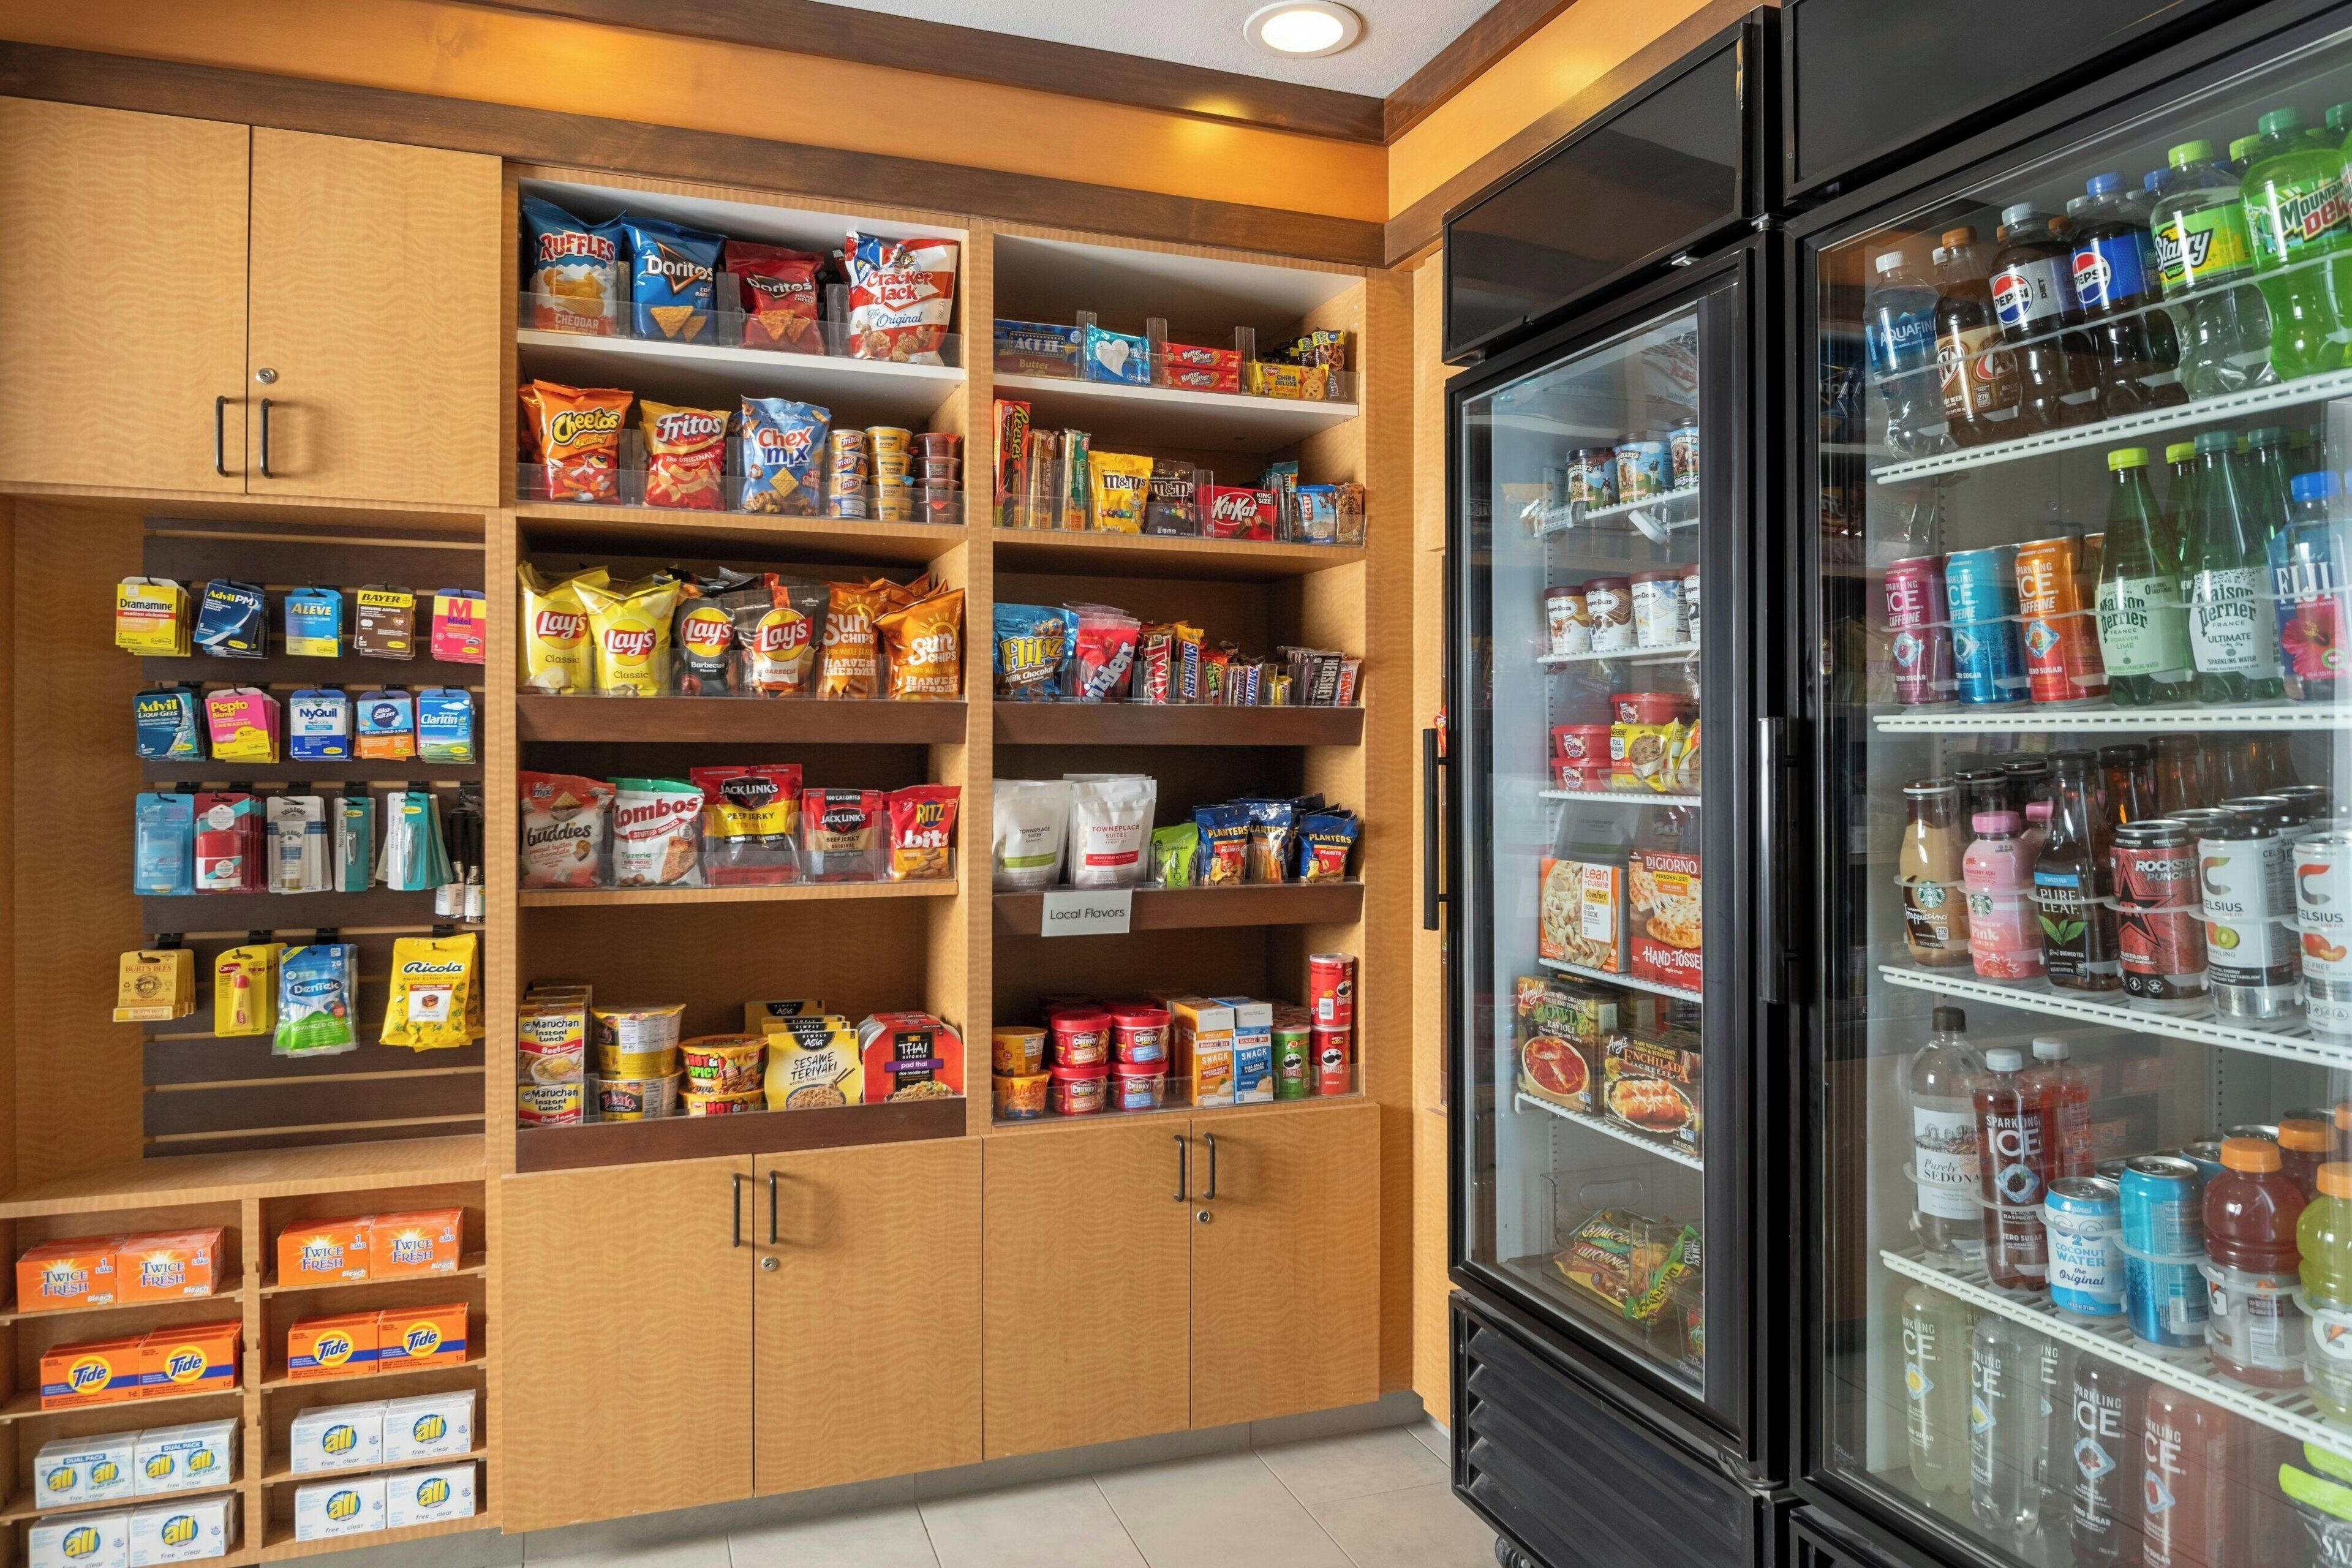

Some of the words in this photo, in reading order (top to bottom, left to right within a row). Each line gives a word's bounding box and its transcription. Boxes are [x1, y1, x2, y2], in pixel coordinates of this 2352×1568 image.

[540, 232, 615, 263] RUFFLES
[646, 254, 714, 282] Doritos
[745, 276, 813, 293] Doritos
[867, 271, 933, 287] Cracker
[873, 285, 919, 305] Jack
[1995, 290, 2029, 307] PEPSI
[556, 313, 599, 329] CHEDDAR
[876, 312, 922, 328] Original
[1015, 337, 1041, 351] ACT
[1182, 349, 1202, 360] Nutter
[1019, 359, 1049, 369] Butter
[552, 408, 620, 445] Cheetos
[657, 413, 723, 443] Fritos
[1011, 404, 1030, 461] Reese's
[575, 435, 608, 448] Crunchy
[758, 426, 812, 448] Chex
[679, 453, 715, 462] ORIGINAL
[766, 443, 809, 467] mix
[1102, 473, 1147, 491] m&m's
[1212, 496, 1257, 521] KitKat
[2016, 562, 2052, 574] SPARKLING
[2018, 573, 2054, 597] ICE
[208, 590, 235, 602] Advil
[362, 594, 401, 603] BAYER
[1887, 590, 1918, 611] ICE
[120, 599, 172, 610] Dramamine
[291, 603, 332, 616] ALEVE
[2021, 597, 2055, 614] CAFFEINE
[538, 611, 587, 639] Lay's
[1889, 611, 1920, 627] CAFFEINE
[686, 616, 733, 646] Lay's
[761, 619, 809, 652] Lay's
[2208, 632, 2252, 643] ULTIMATE
[607, 628, 654, 657] Lay's
[840, 633, 873, 644] CHIPS
[545, 655, 579, 663] Classic
[927, 652, 956, 663] CHIPS
[1001, 637, 1065, 674] Flipz
[614, 671, 649, 679] Classic
[1183, 641, 1199, 698] SNICKERS
[907, 675, 959, 685] HARVEST
[137, 699, 178, 712] Advil
[211, 700, 248, 712] Pepto
[300, 709, 337, 719] NyQuil
[421, 714, 458, 725] Claritin
[1566, 774, 1580, 783] Dibs
[820, 815, 841, 824] JACK
[842, 814, 865, 823] LINK'S
[916, 804, 944, 824] RITZ
[528, 822, 592, 846] buddies
[633, 829, 657, 838] STUFFED
[657, 820, 679, 833] SNACKS
[1208, 826, 1248, 838] PLANTERS
[905, 830, 948, 848] bits
[1309, 834, 1351, 843] PLANTERS
[1646, 856, 1697, 874] DIGIORNO
[1585, 868, 1608, 881] Lean
[2147, 870, 2196, 881] PUNCHED
[1586, 891, 1607, 900] Comfort
[2040, 888, 2076, 899] PURE
[1050, 910, 1080, 919] Local
[1085, 908, 1125, 918] Flavors
[2042, 903, 2076, 914] LEAF
[404, 962, 463, 973] Ricola
[294, 981, 339, 994] DenTek
[1519, 983, 1544, 1006] Amy's
[533, 1019, 579, 1030] Maruchan
[1547, 1019, 1574, 1033] RAVIOLI
[804, 1038, 824, 1047] Asia
[899, 1043, 927, 1055] THAI
[1607, 1035, 1628, 1055] Amy's
[689, 1054, 708, 1066] HOT
[794, 1052, 834, 1069] SESAME
[1201, 1052, 1228, 1065] SNACK
[1241, 1048, 1267, 1060] SNACK
[689, 1066, 718, 1078] SPICY
[791, 1061, 837, 1080] TERIYAKI
[1322, 1065, 1343, 1074] PRINGLES
[1623, 1049, 1691, 1084] ENCHILADA
[1988, 1128, 2041, 1158] ICE
[1924, 1158, 1958, 1173] Purely
[392, 1238, 432, 1250] TWICE
[2056, 1242, 2105, 1256] COCONUT
[392, 1251, 433, 1263] FRESH
[2056, 1252, 2105, 1267] WATER
[42, 1271, 88, 1284] TWICE
[2059, 1269, 2105, 1286] Original
[42, 1283, 88, 1296] FRESH
[87, 1294, 113, 1302] Bleach
[317, 1340, 349, 1361] Tide
[169, 1355, 203, 1378] Tide
[73, 1365, 107, 1388] Tide
[324, 1425, 354, 1453] all
[48, 1468, 75, 1491] all
[419, 1479, 448, 1507] all
[163, 1517, 195, 1546] all
